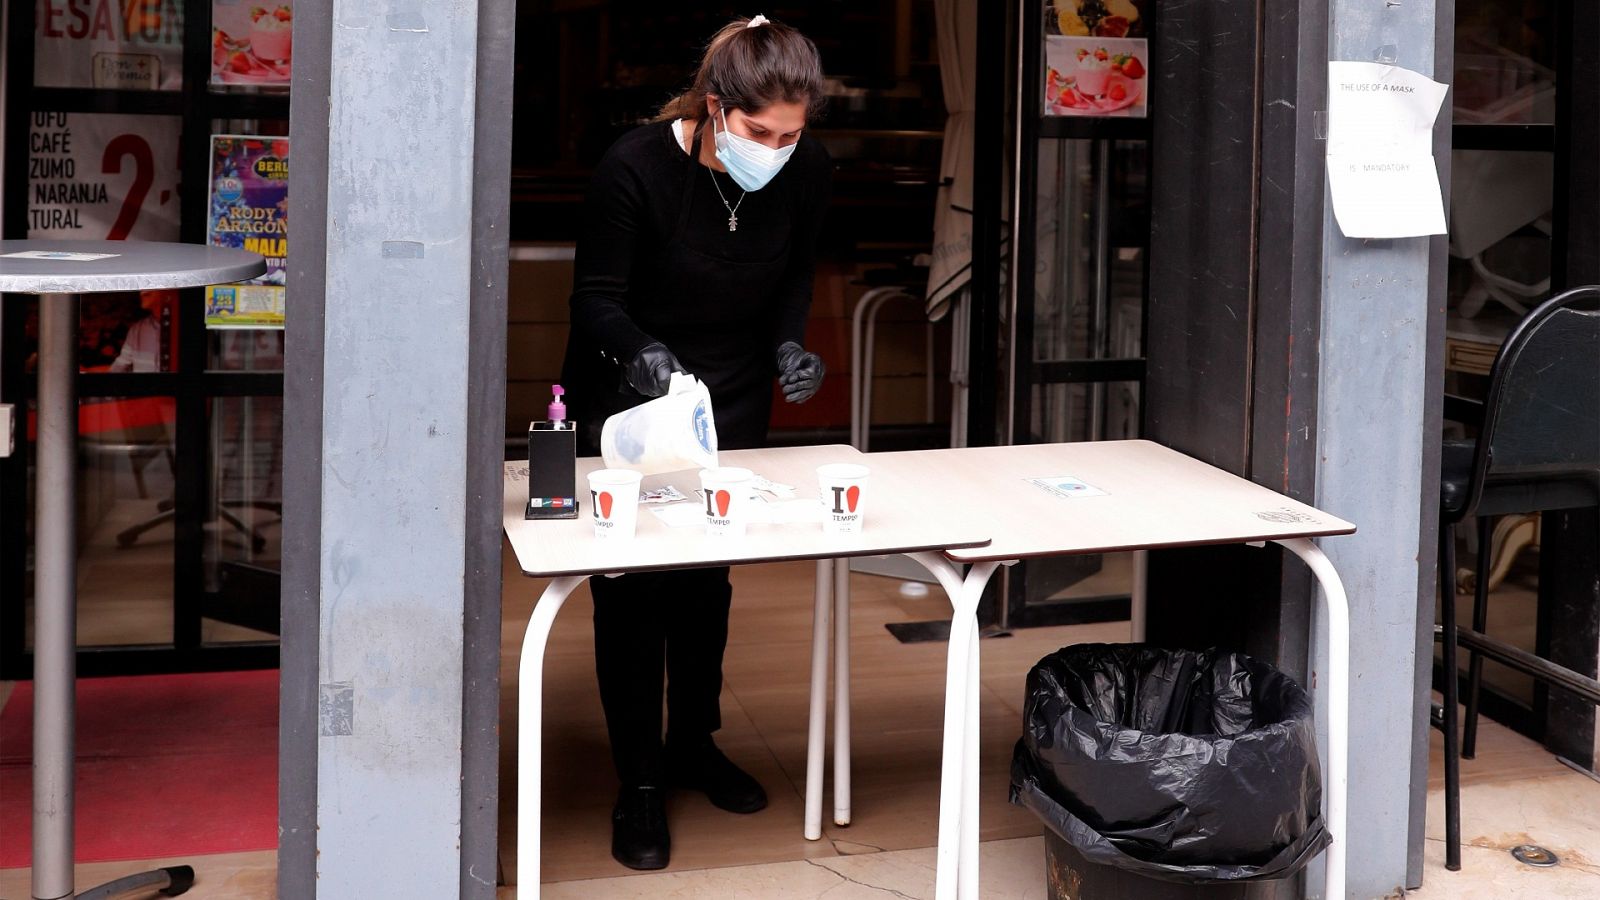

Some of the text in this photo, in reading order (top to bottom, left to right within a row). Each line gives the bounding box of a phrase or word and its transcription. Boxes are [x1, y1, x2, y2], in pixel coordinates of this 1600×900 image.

[1340, 83, 1355, 92] THE
[1356, 83, 1370, 92] USE
[1371, 83, 1382, 92] OF
[1390, 85, 1415, 93] MASK
[30, 128, 71, 153] CAFÉ
[30, 158, 75, 179] ZUMO
[1349, 163, 1410, 172] IS MANDATORY
[35, 183, 108, 204] NARANJA
[27, 208, 82, 230] TURAL
[230, 207, 277, 221] RODY
